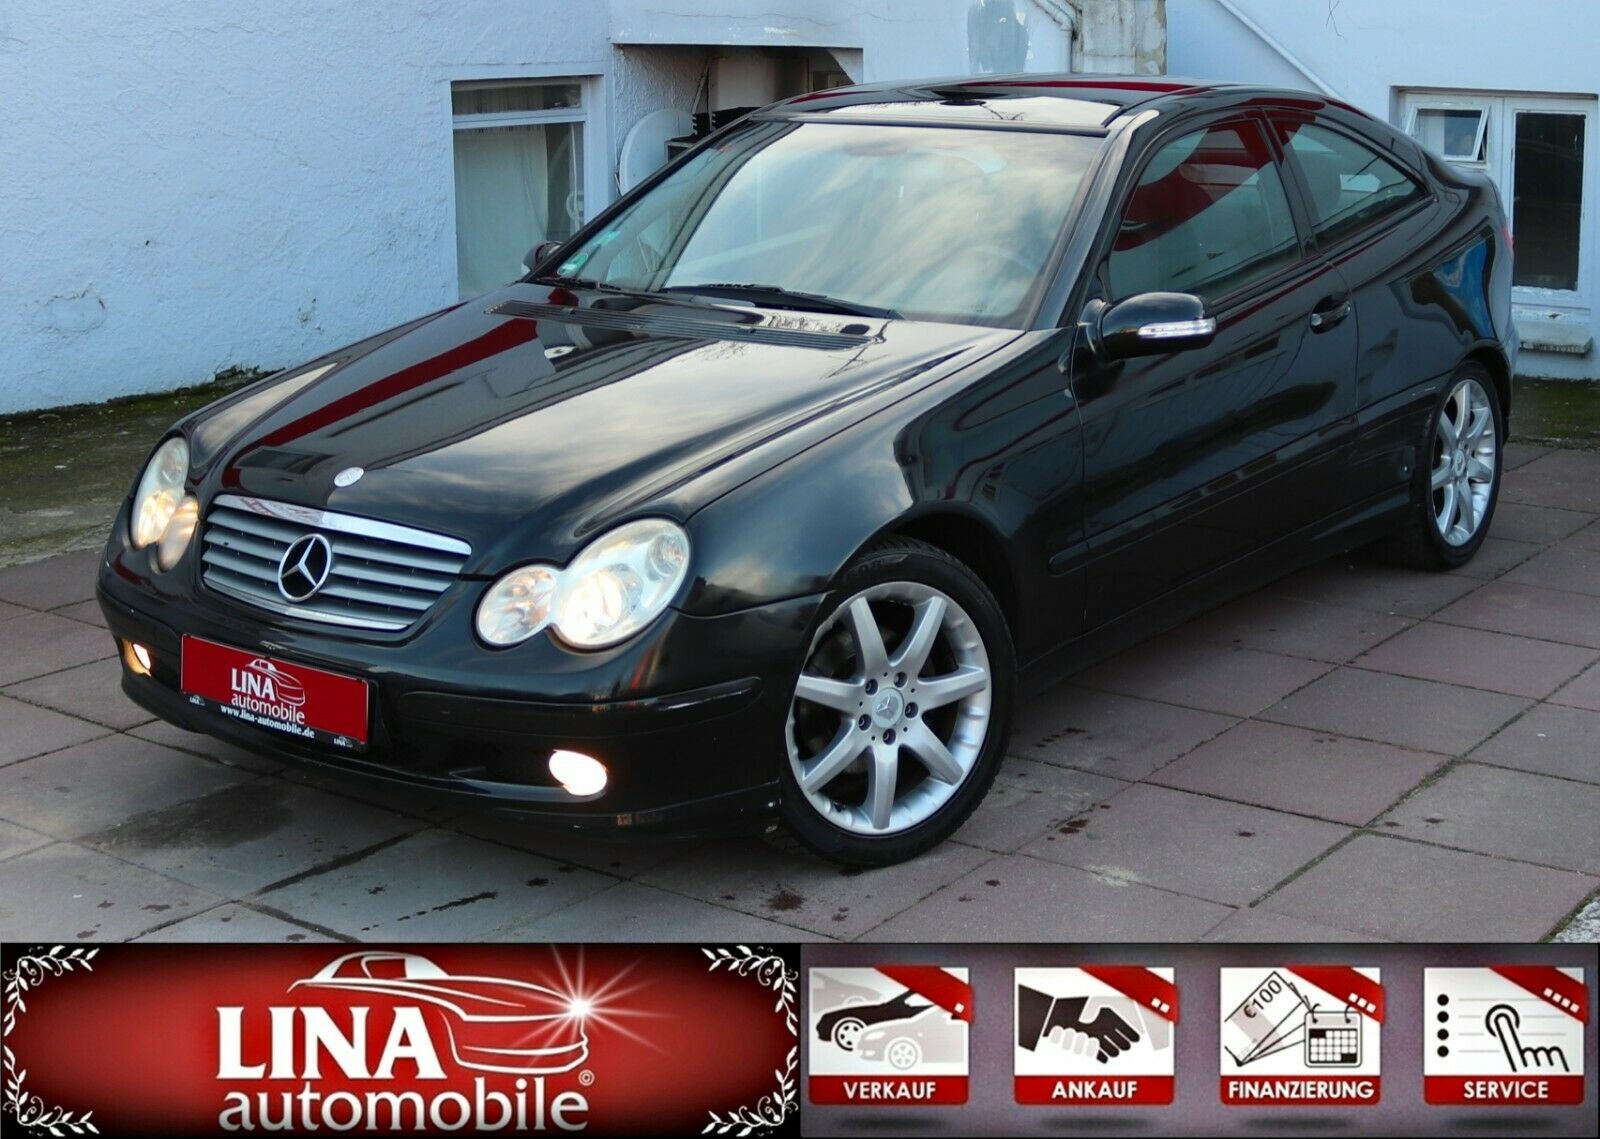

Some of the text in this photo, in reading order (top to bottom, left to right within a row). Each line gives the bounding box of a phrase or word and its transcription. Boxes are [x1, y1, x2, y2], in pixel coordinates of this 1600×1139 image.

[231, 668, 276, 702] LINA
[220, 704, 315, 739] www.lina-automobile.de
[231, 693, 306, 725] automobile
